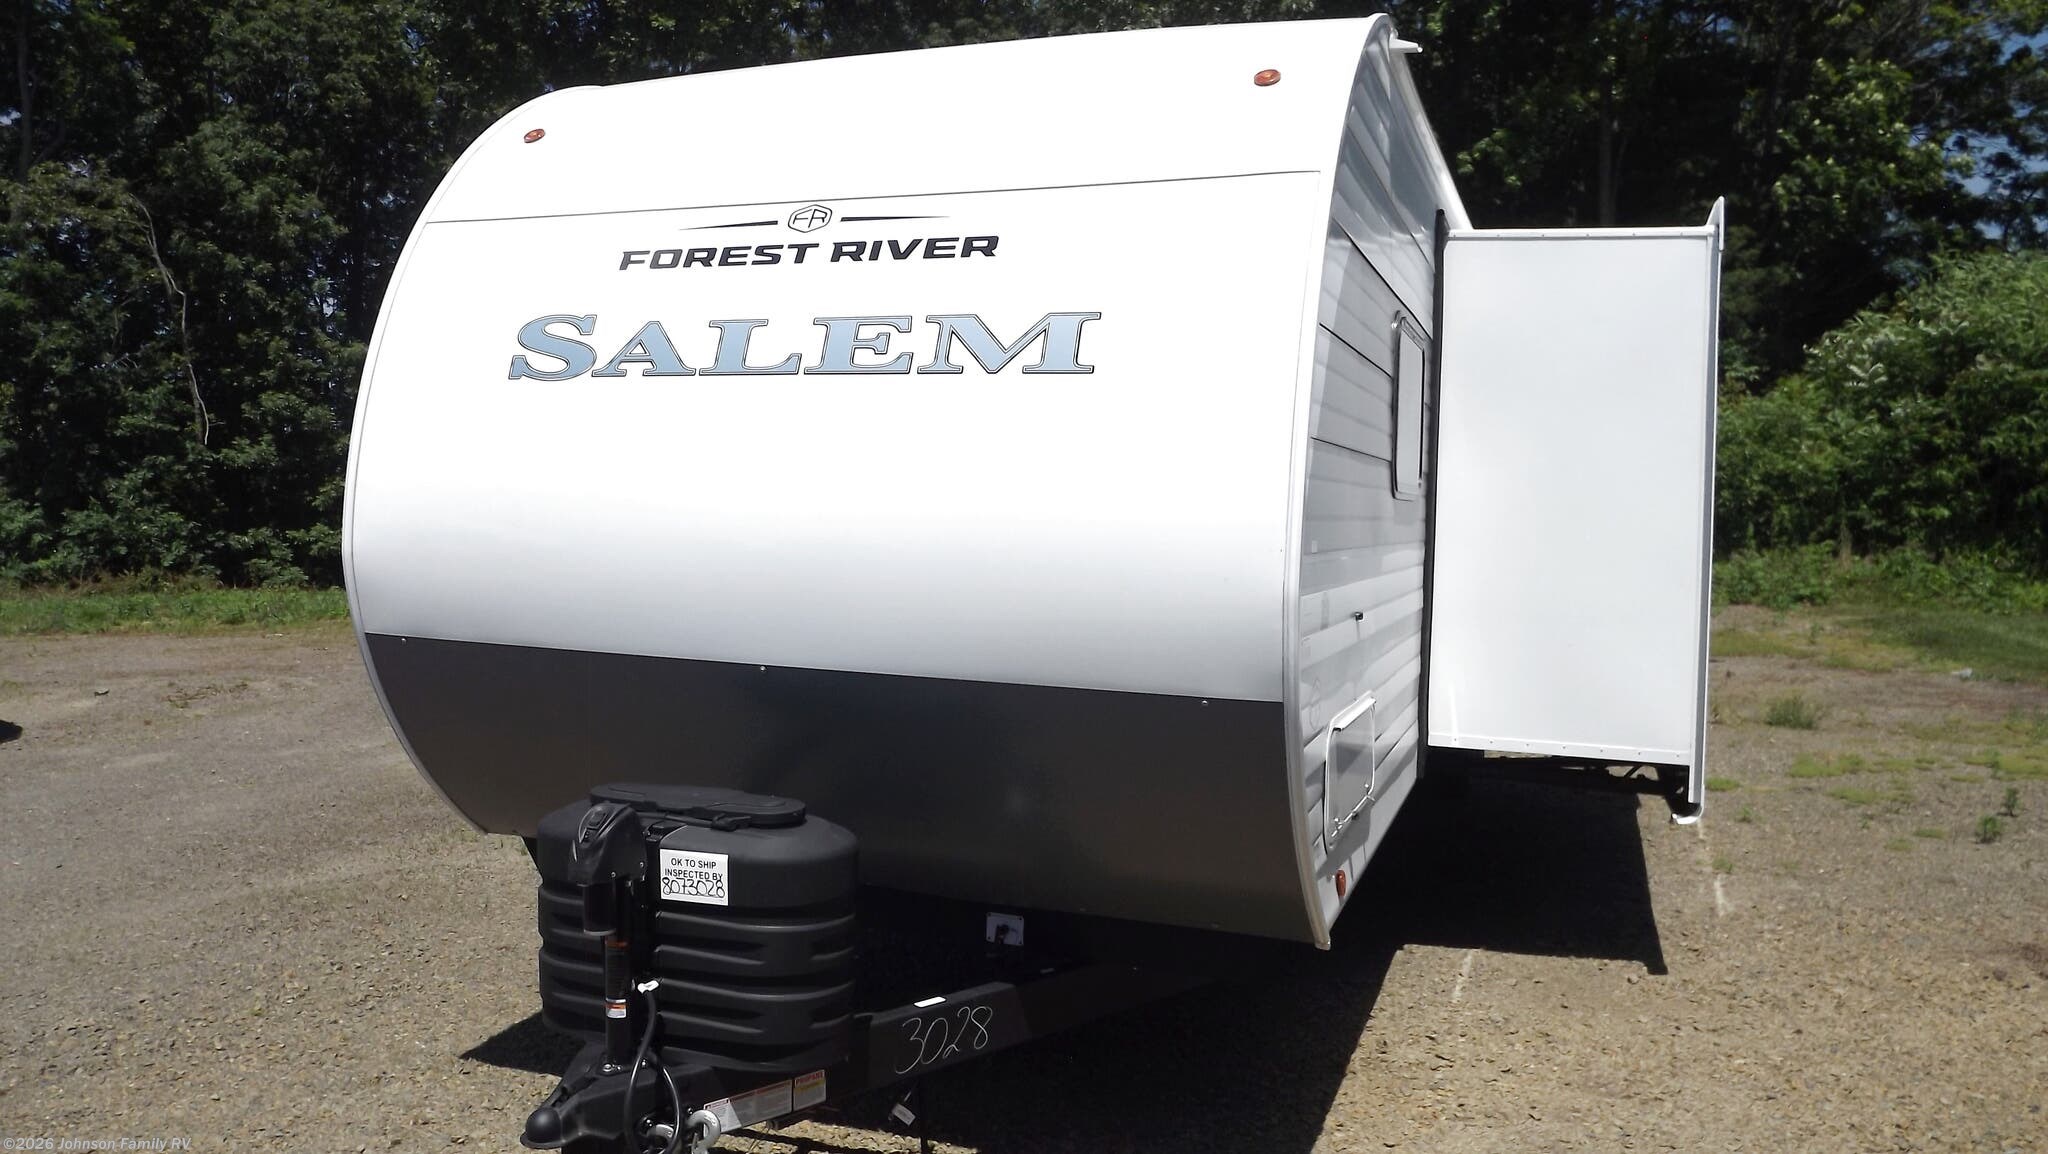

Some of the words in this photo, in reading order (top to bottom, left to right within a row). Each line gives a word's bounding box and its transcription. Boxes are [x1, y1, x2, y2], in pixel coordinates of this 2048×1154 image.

[619, 243, 820, 271] FOREST
[830, 235, 999, 263] RIVER
[508, 311, 1102, 381] SALEM
[665, 868, 710, 879] INSPECTED
[712, 872, 723, 881] BY
[671, 858, 682, 866] OK
[685, 859, 695, 867] TO
[698, 860, 716, 869] SHIP
[662, 876, 725, 898] 8073028
[895, 1006, 993, 1074] 3028
